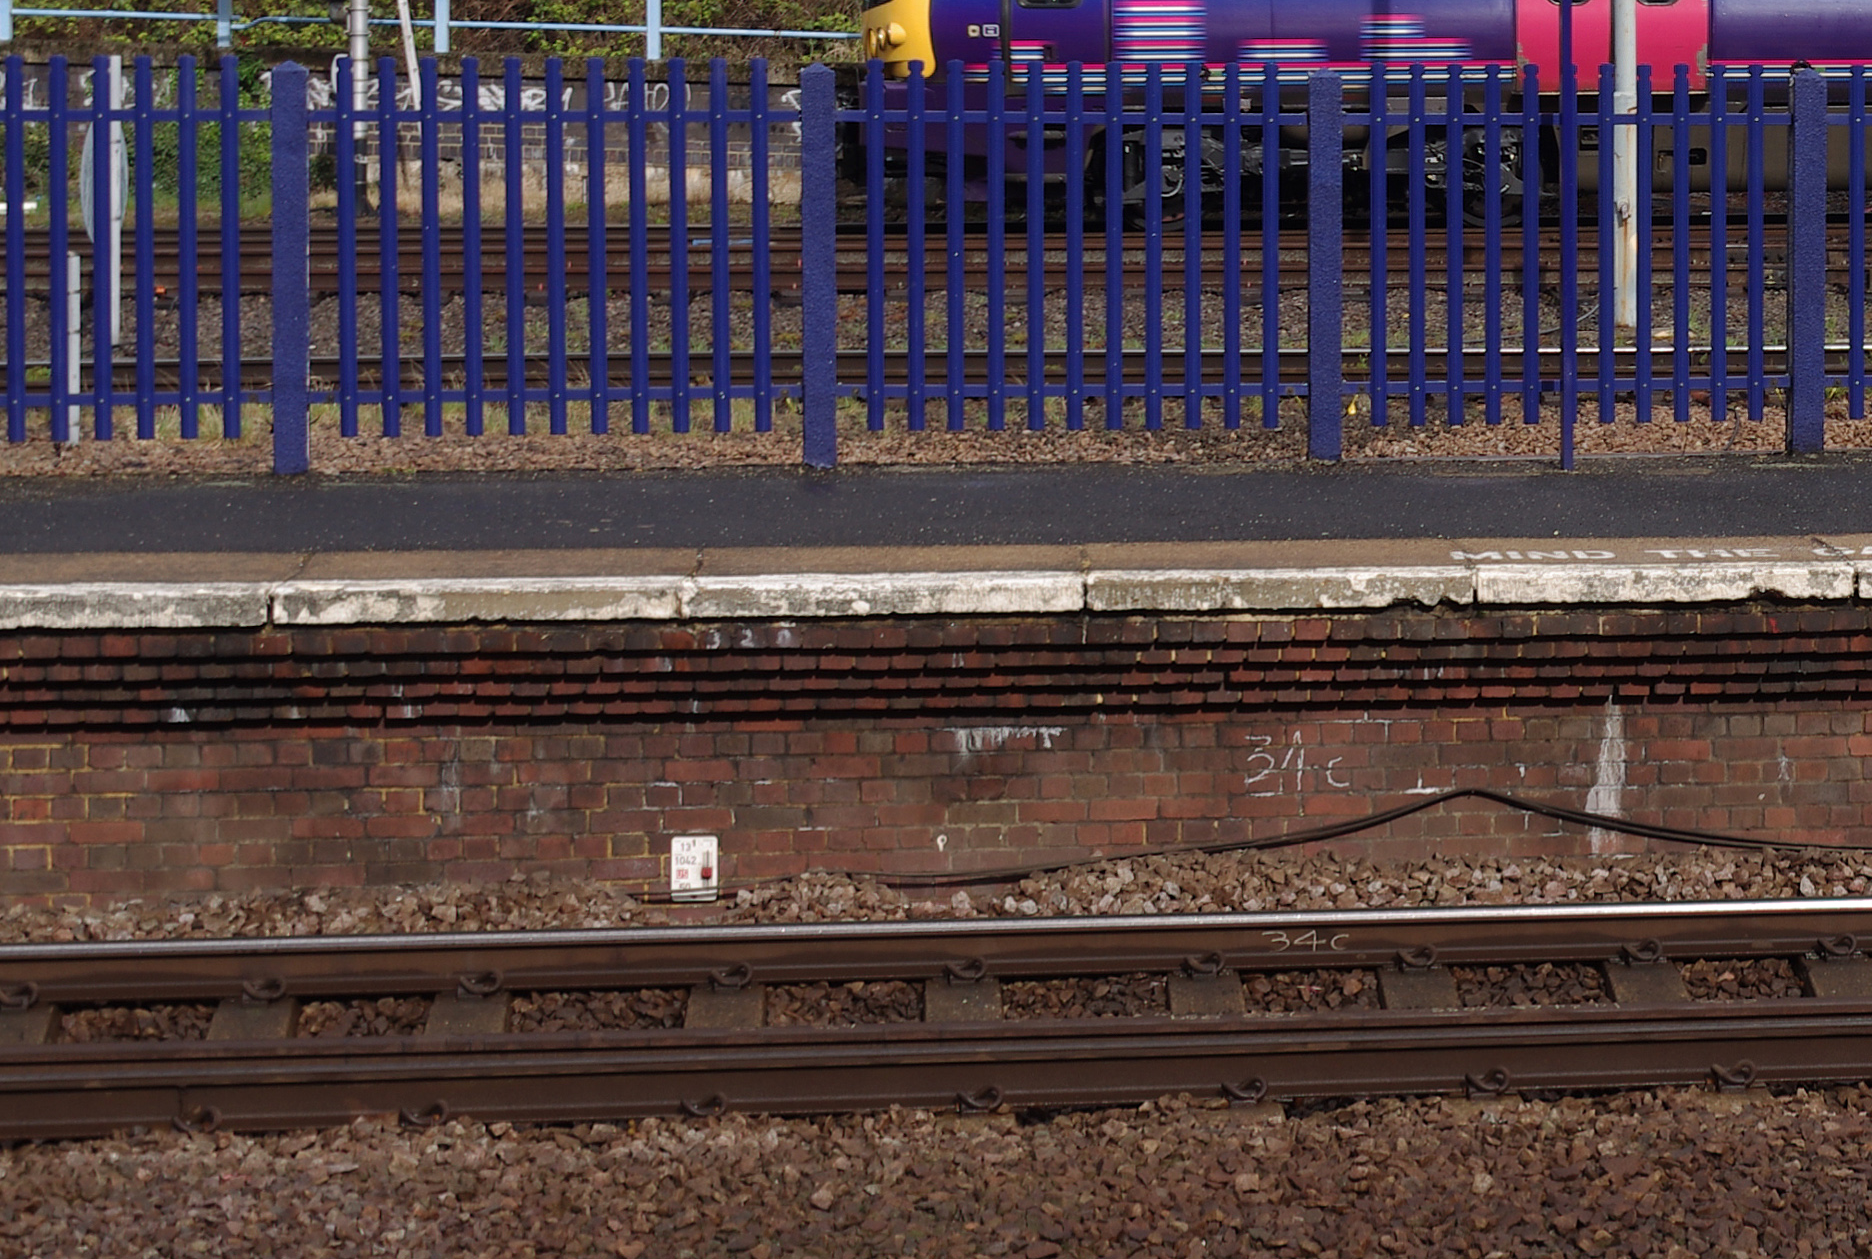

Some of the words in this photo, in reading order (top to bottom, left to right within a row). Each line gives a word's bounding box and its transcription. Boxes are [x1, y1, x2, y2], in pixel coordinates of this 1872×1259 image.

[1449, 549, 1617, 561] MIND
[1644, 547, 1780, 559] THE
[675, 855, 697, 865] 1042
